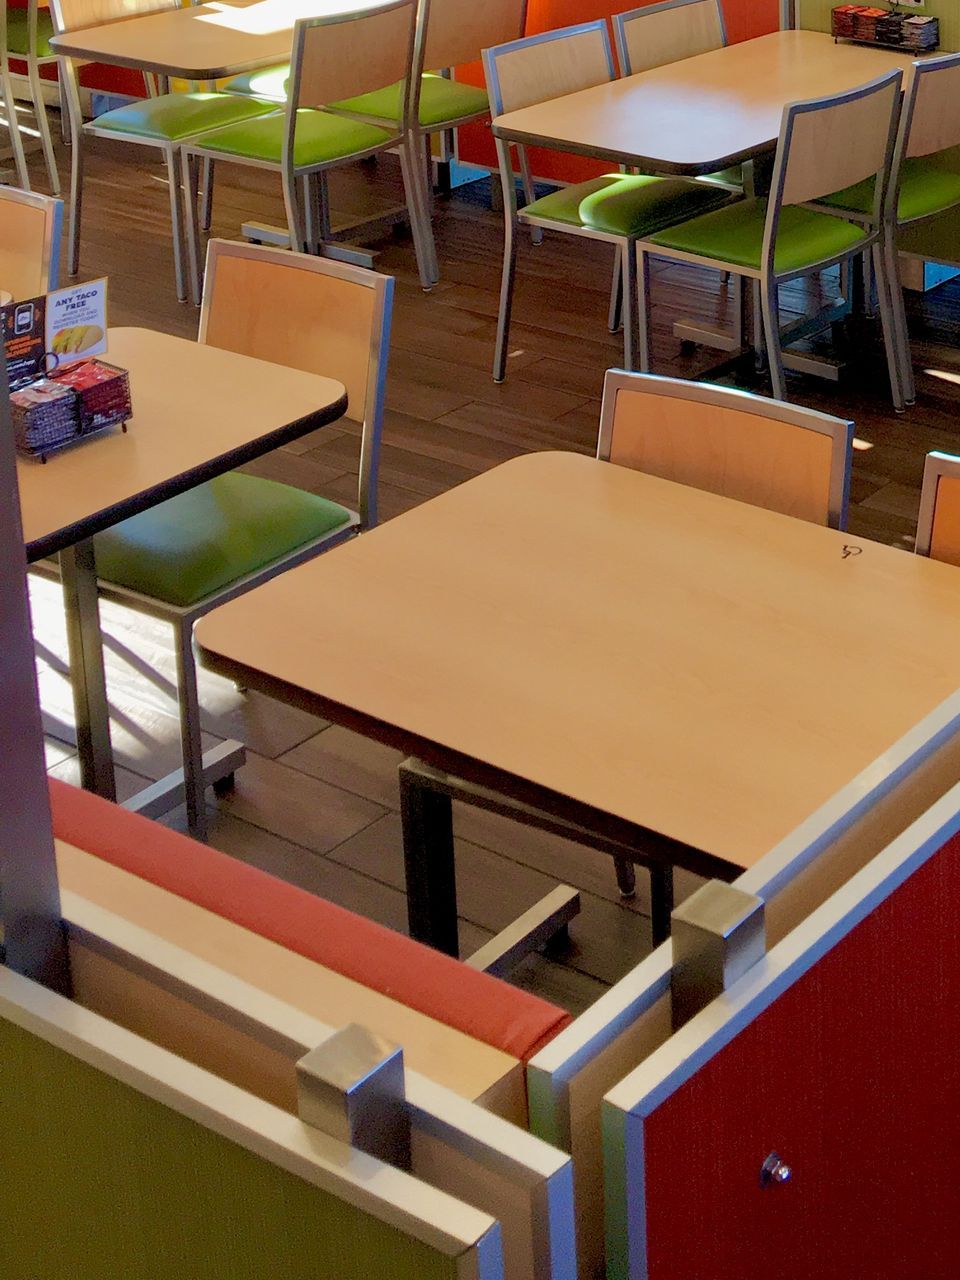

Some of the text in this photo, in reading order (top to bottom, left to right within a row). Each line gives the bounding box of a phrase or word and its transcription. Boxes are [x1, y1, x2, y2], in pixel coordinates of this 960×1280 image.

[55, 290, 98, 307] ANY TACO
[65, 300, 87, 311] FREE
